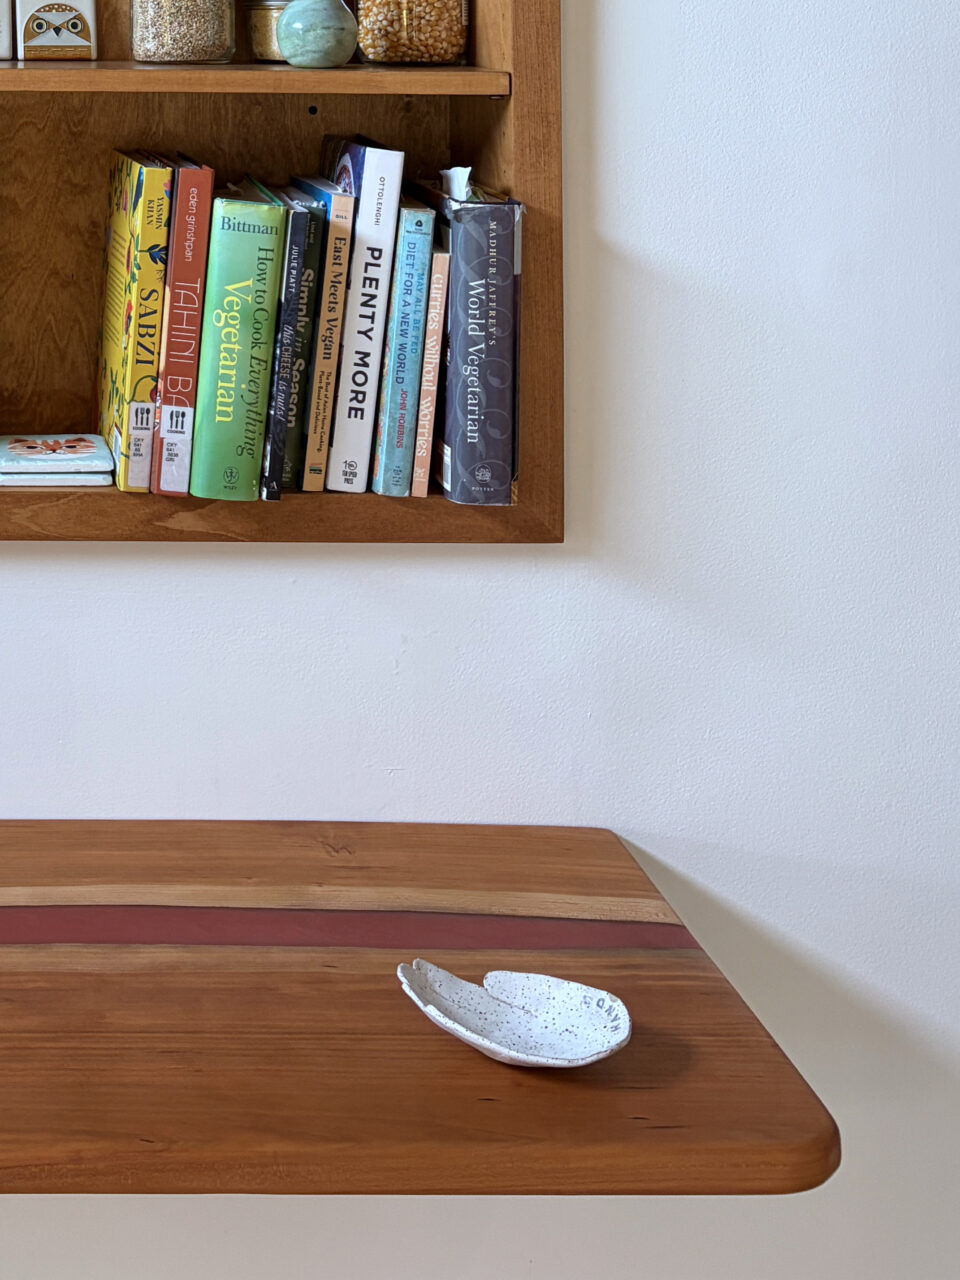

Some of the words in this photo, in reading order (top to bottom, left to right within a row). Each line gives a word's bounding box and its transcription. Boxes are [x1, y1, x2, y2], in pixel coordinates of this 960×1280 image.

[146, 200, 154, 226] KHAN
[155, 197, 164, 230] YASMIN
[188, 187, 198, 213] eden
[374, 176, 386, 226] OTTOLENGHI
[184, 215, 196, 262] grinshpan
[220, 216, 279, 236] Bittman
[256, 247, 274, 286] How
[290, 245, 299, 268] JULIE
[332, 237, 346, 267] East
[405, 242, 416, 268] DIET
[488, 220, 497, 274] MADHUR
[254, 289, 268, 305] to
[288, 269, 297, 293] PIATT
[328, 271, 344, 313] Meets
[356, 246, 383, 341] PLENTY
[402, 272, 414, 296] FOR
[417, 272, 425, 292] MAY
[168, 278, 200, 363] TAHINI
[414, 294, 422, 317] ALL
[428, 274, 444, 330] curries
[468, 278, 486, 336] World
[487, 278, 497, 346] JAFFREY'S
[136, 288, 159, 366] SABZI
[250, 308, 270, 351] Cook
[282, 324, 294, 345] this
[320, 317, 338, 361] Vegan
[399, 313, 410, 339] NEW
[410, 337, 418, 354] FED
[413, 321, 420, 334] BE
[212, 278, 254, 423] Vegetarian
[280, 346, 292, 379] CHEESE
[396, 343, 407, 385] WORLD
[422, 336, 440, 390] without
[167, 376, 192, 408] BA
[288, 358, 306, 428] Season
[348, 350, 371, 421] MORE
[399, 388, 408, 411] JOHN
[462, 344, 486, 444] Vegetarian
[236, 353, 268, 459] Everything
[396, 413, 406, 449] ROBBINS
[416, 396, 434, 457] worries
